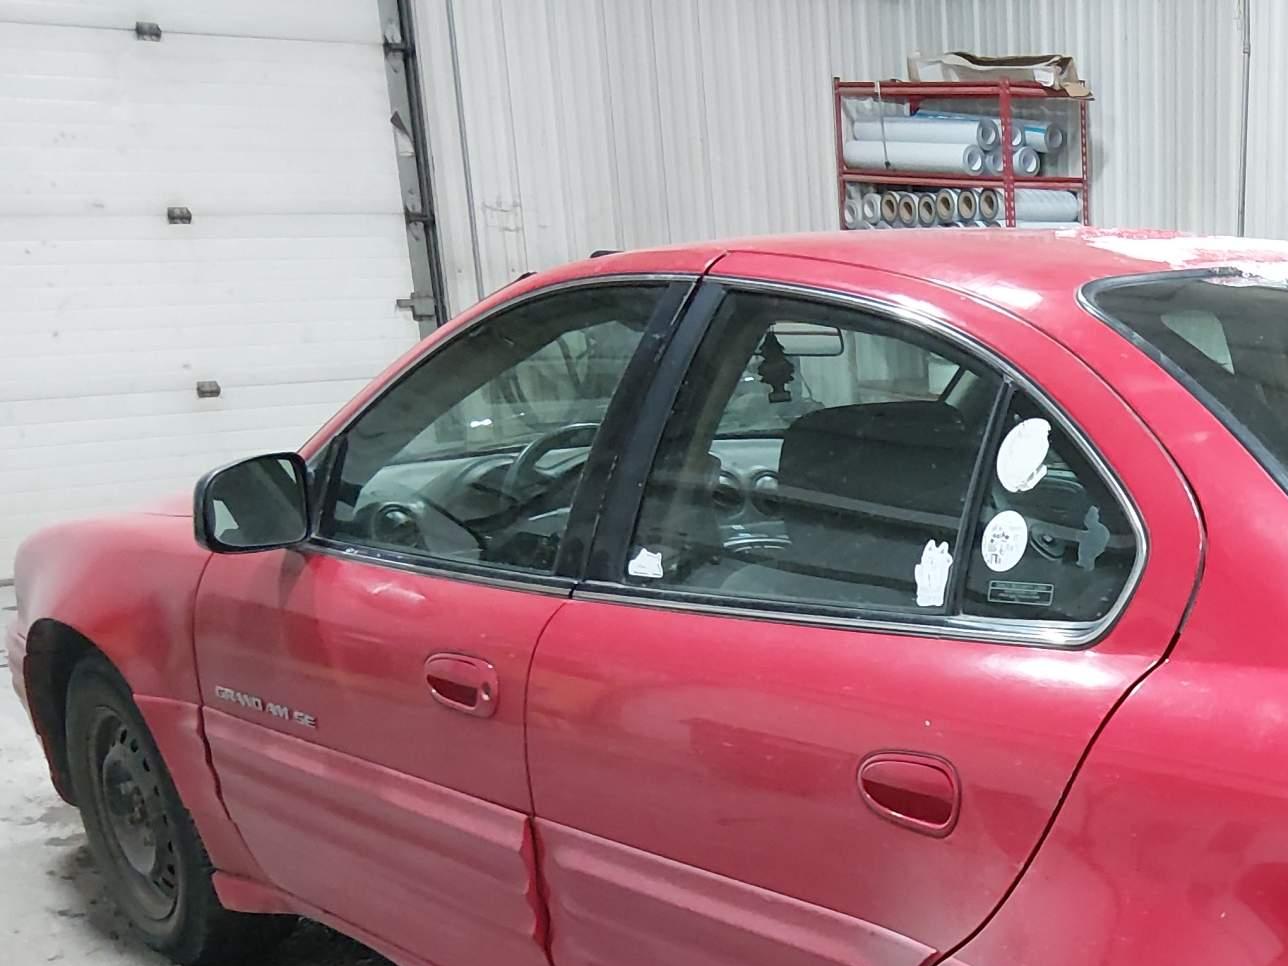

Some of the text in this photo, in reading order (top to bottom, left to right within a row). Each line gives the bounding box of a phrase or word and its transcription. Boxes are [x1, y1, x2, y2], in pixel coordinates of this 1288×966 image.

[215, 685, 316, 729] GRAND AM SE
